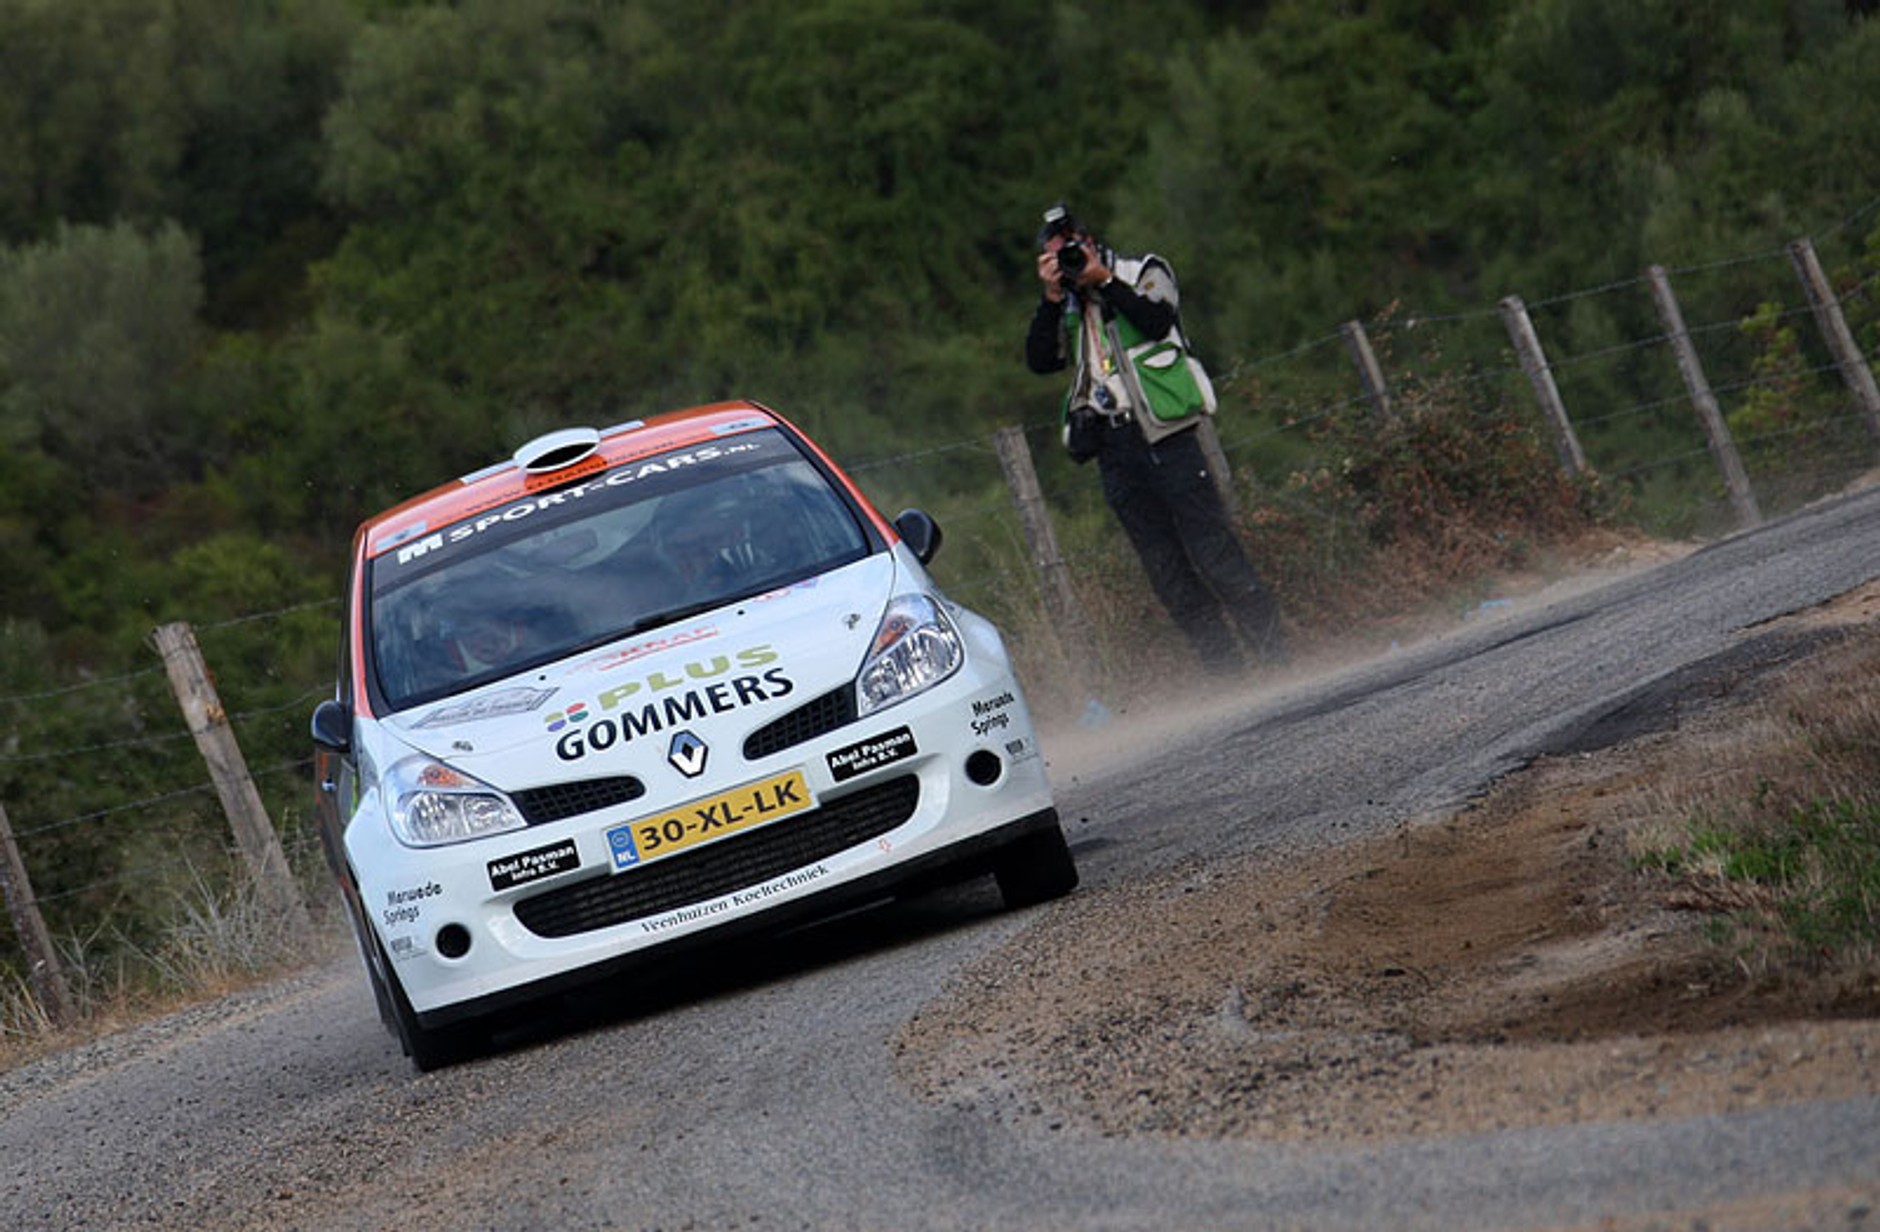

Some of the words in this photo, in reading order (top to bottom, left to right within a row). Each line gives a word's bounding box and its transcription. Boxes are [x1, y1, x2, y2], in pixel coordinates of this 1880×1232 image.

[397, 532, 444, 565] M
[597, 644, 779, 710] PLUS
[556, 667, 794, 761] GOMMERS
[831, 751, 861, 769] Abel
[862, 732, 911, 758] Pasman
[639, 779, 801, 851] 30-XL-LK
[491, 859, 519, 878] Abel
[521, 846, 576, 869] Pasman
[616, 851, 637, 865] NL
[383, 904, 421, 926] Springs
[640, 901, 729, 934] Veenhuizen
